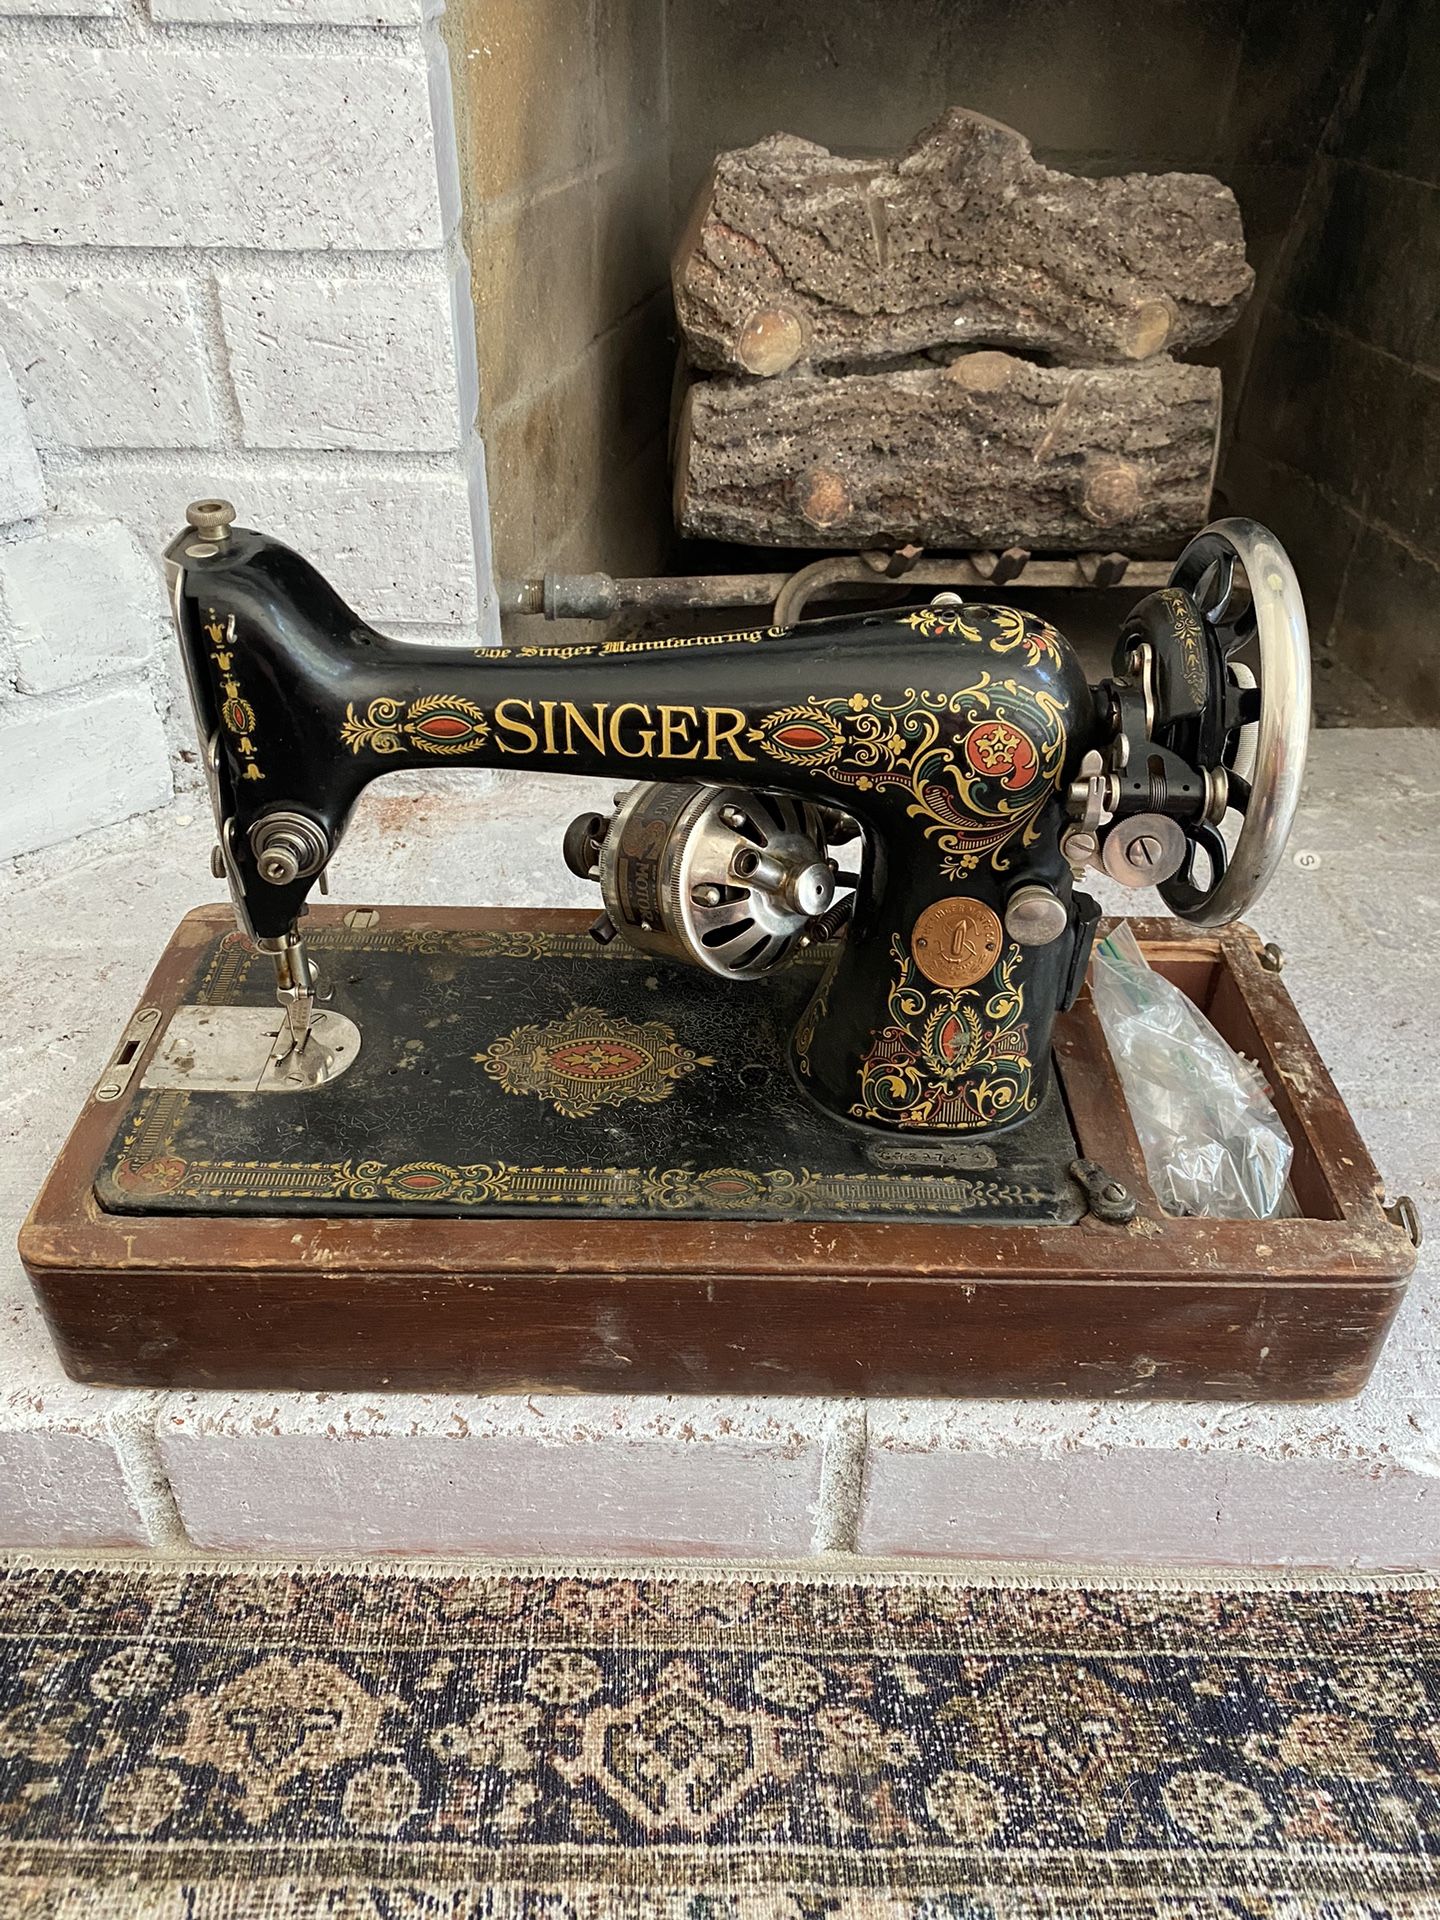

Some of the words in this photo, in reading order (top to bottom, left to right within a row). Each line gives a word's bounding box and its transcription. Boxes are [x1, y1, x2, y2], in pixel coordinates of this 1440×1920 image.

[515, 645, 598, 660] Singer
[598, 631, 762, 657] Manufacturing
[494, 698, 756, 762] SINGER
